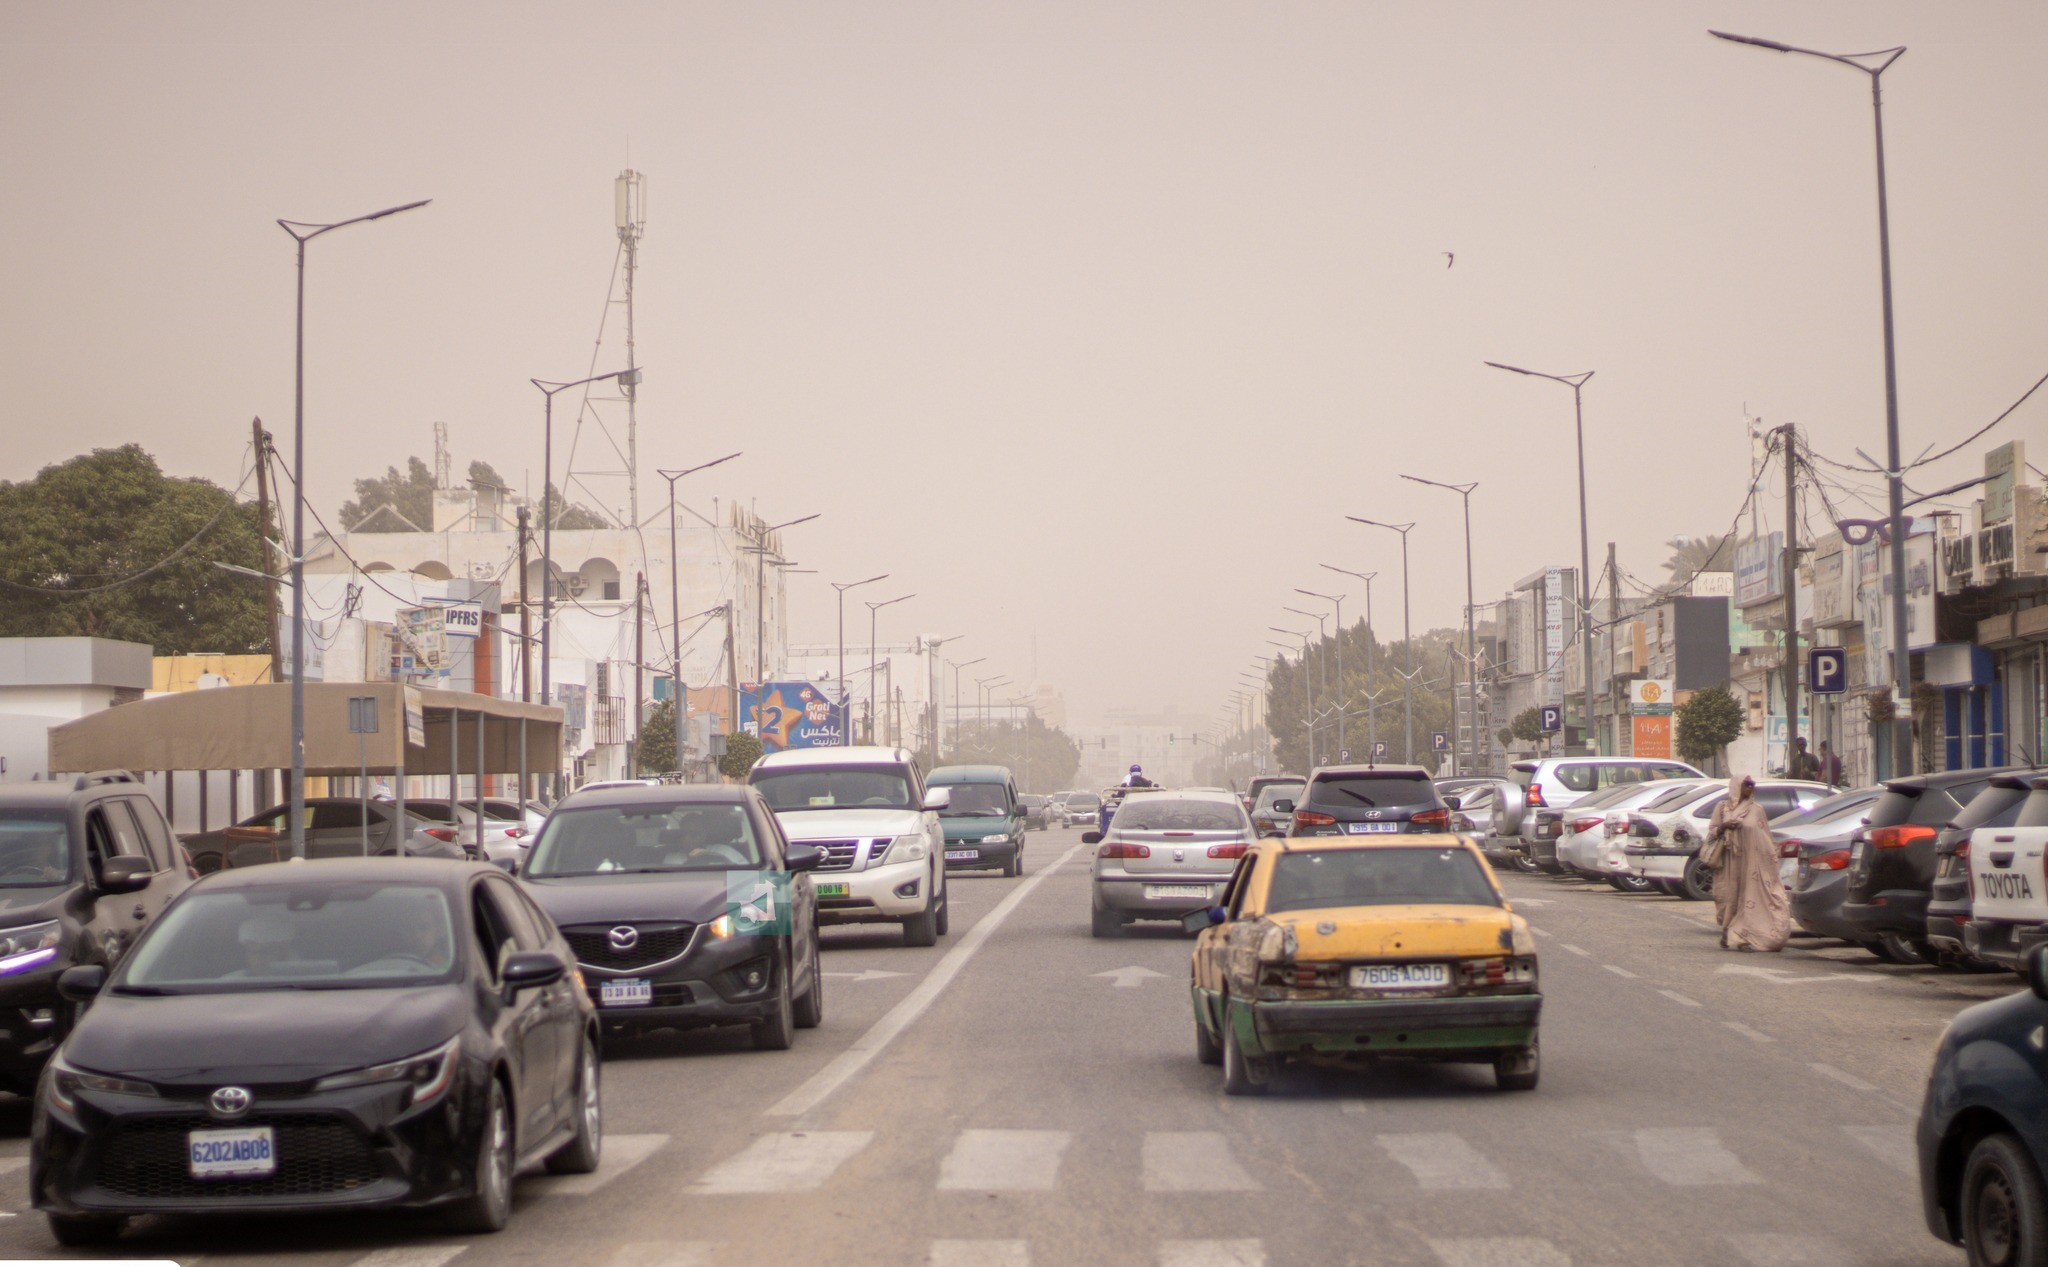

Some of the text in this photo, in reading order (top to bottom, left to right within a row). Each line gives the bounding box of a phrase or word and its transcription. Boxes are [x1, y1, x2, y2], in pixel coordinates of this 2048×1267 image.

[445, 609, 479, 626] IPFRS
[1818, 655, 1838, 686] P
[800, 690, 812, 698] 4G
[1545, 710, 1557, 728] P
[1376, 744, 1384, 755] P
[1435, 735, 1444, 749] P
[1321, 757, 1328, 766] P
[1342, 751, 1348, 760] P
[1981, 873, 2033, 899] TOYOTA
[192, 1139, 270, 1163] 6202AB08
